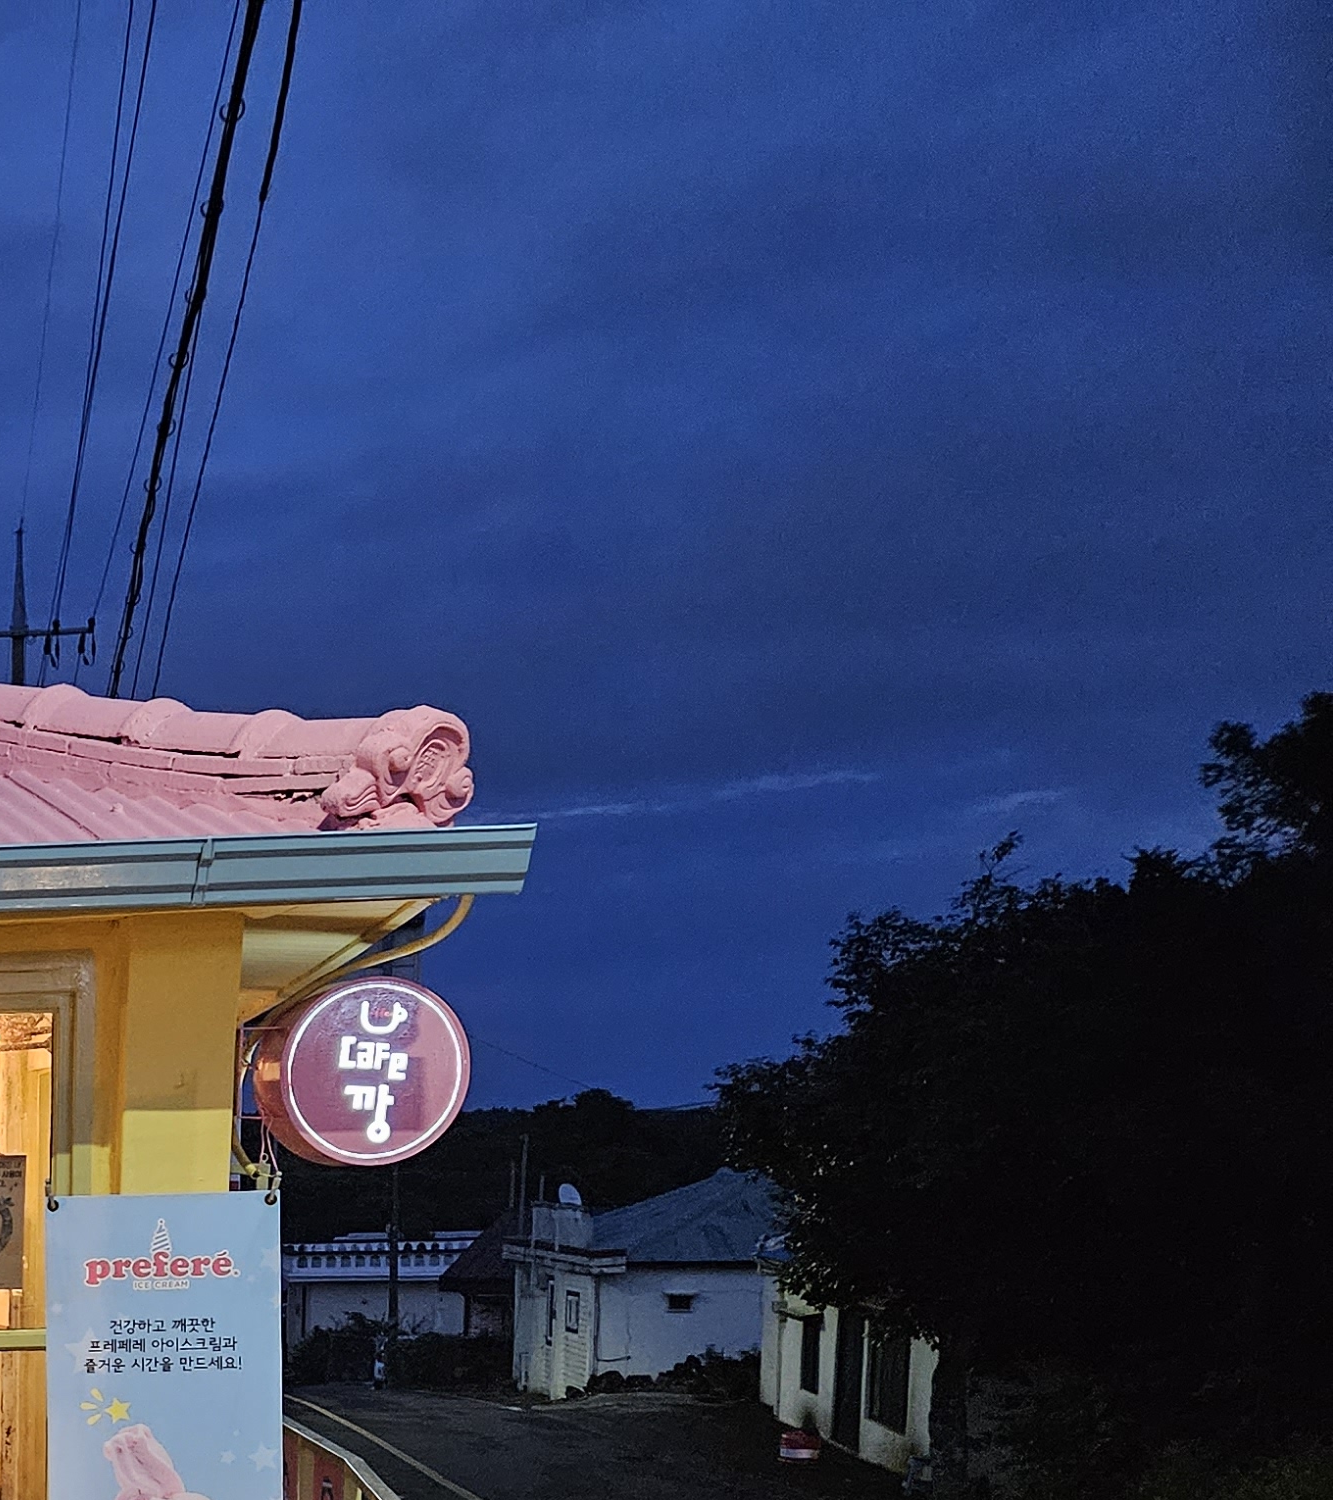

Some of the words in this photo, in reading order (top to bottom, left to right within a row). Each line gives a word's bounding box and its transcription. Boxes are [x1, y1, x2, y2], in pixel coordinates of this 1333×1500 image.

[344, 1084, 394, 1144] 깡
[134, 1281, 150, 1289] ICE
[154, 1280, 188, 1288] CREAM
[109, 1319, 167, 1335] 건강하고
[171, 1317, 216, 1333] 깨끗한
[88, 1338, 146, 1353] 프레페레
[151, 1336, 238, 1351] 아이스크림과
[84, 1358, 126, 1374] 즐거운
[131, 1357, 174, 1373] 시간을
[179, 1355, 242, 1372] 만드세요!
